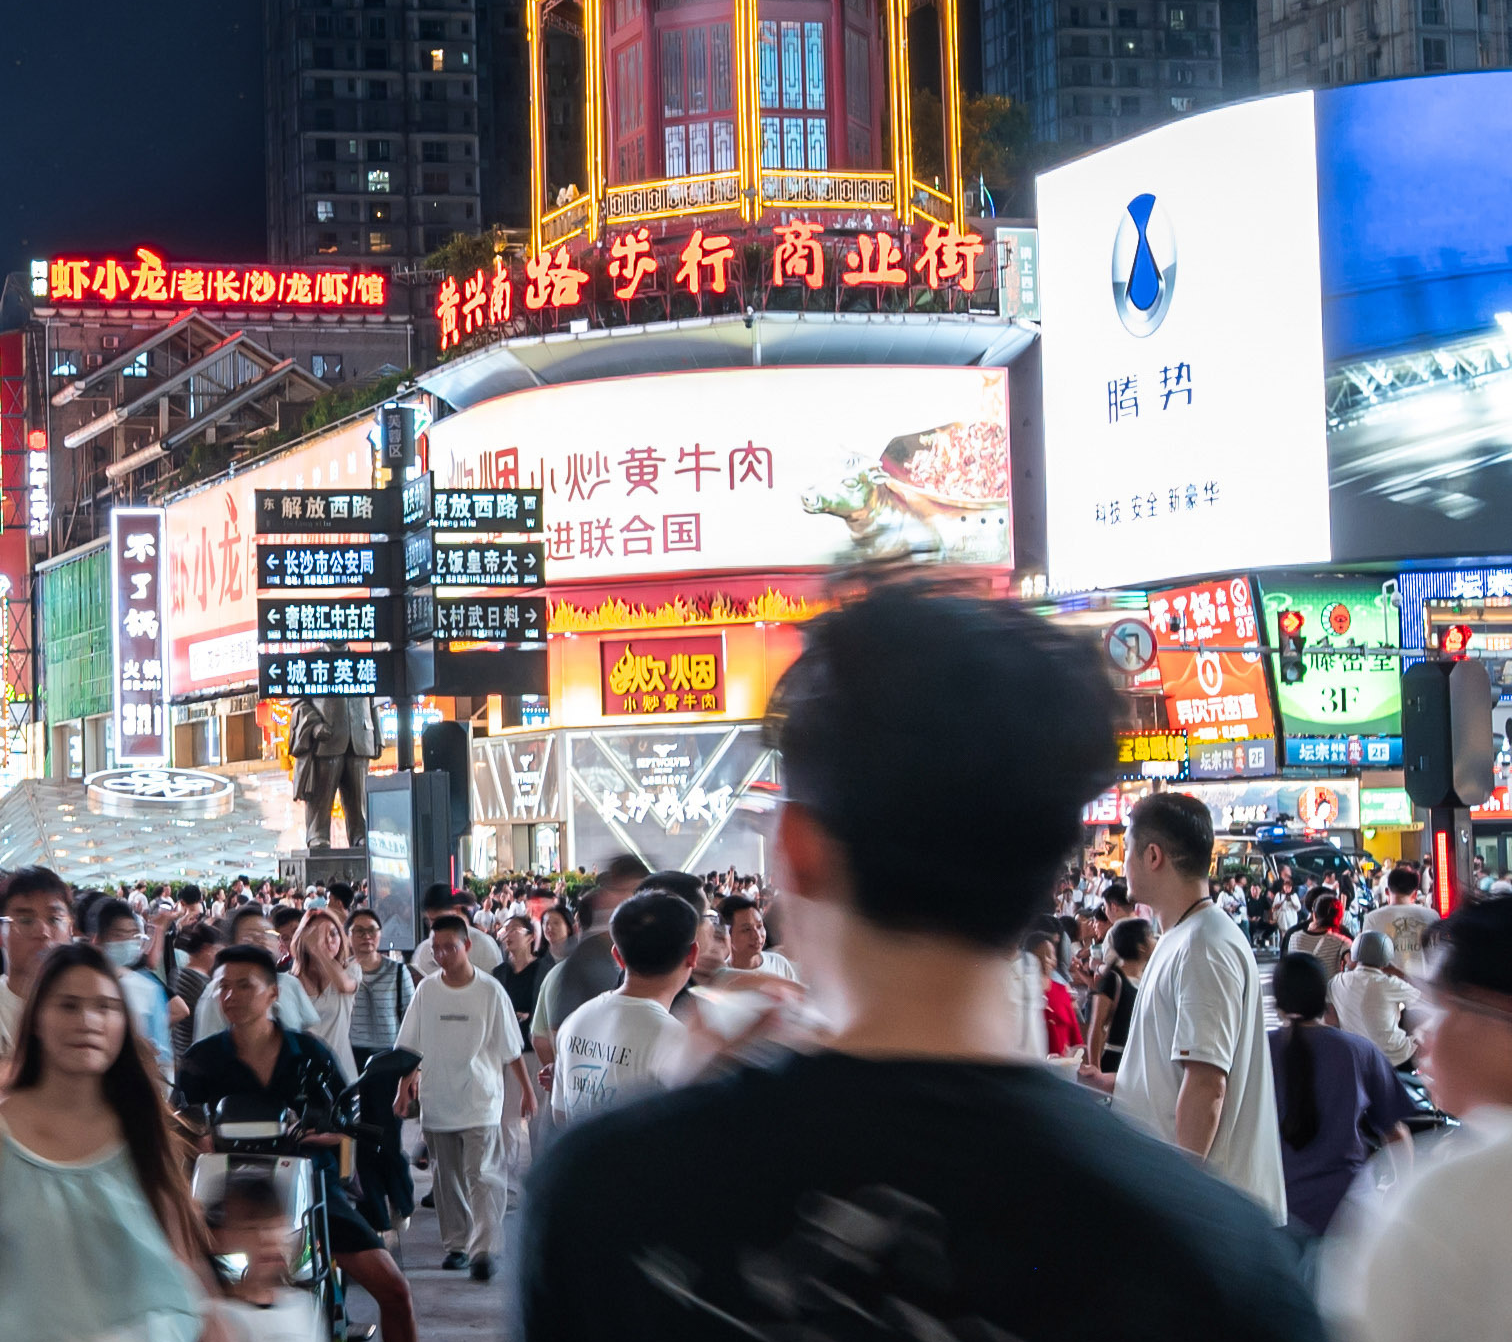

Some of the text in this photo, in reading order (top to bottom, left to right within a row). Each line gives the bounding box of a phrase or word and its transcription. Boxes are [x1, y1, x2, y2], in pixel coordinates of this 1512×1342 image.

[436, 219, 987, 351] 黄兴南路步行商业街
[1106, 362, 1192, 424] 腾势
[387, 414, 403, 458] 芙蓉区
[263, 495, 374, 520] 东 解放西路
[1094, 480, 1220, 526] 科技 安全 新豪华
[542, 512, 702, 561] 进联合国
[284, 549, 374, 575] 长沙市公安局
[123, 533, 159, 640] 不了锅
[285, 604, 376, 629] 奢铭汇中古店
[287, 659, 377, 684] 城市英雄
[624, 694, 718, 713] 小炒黄牛肉
[1321, 686, 1360, 714] 3F
[1251, 750, 1266, 766] 2F
[1371, 744, 1388, 761] 2F
